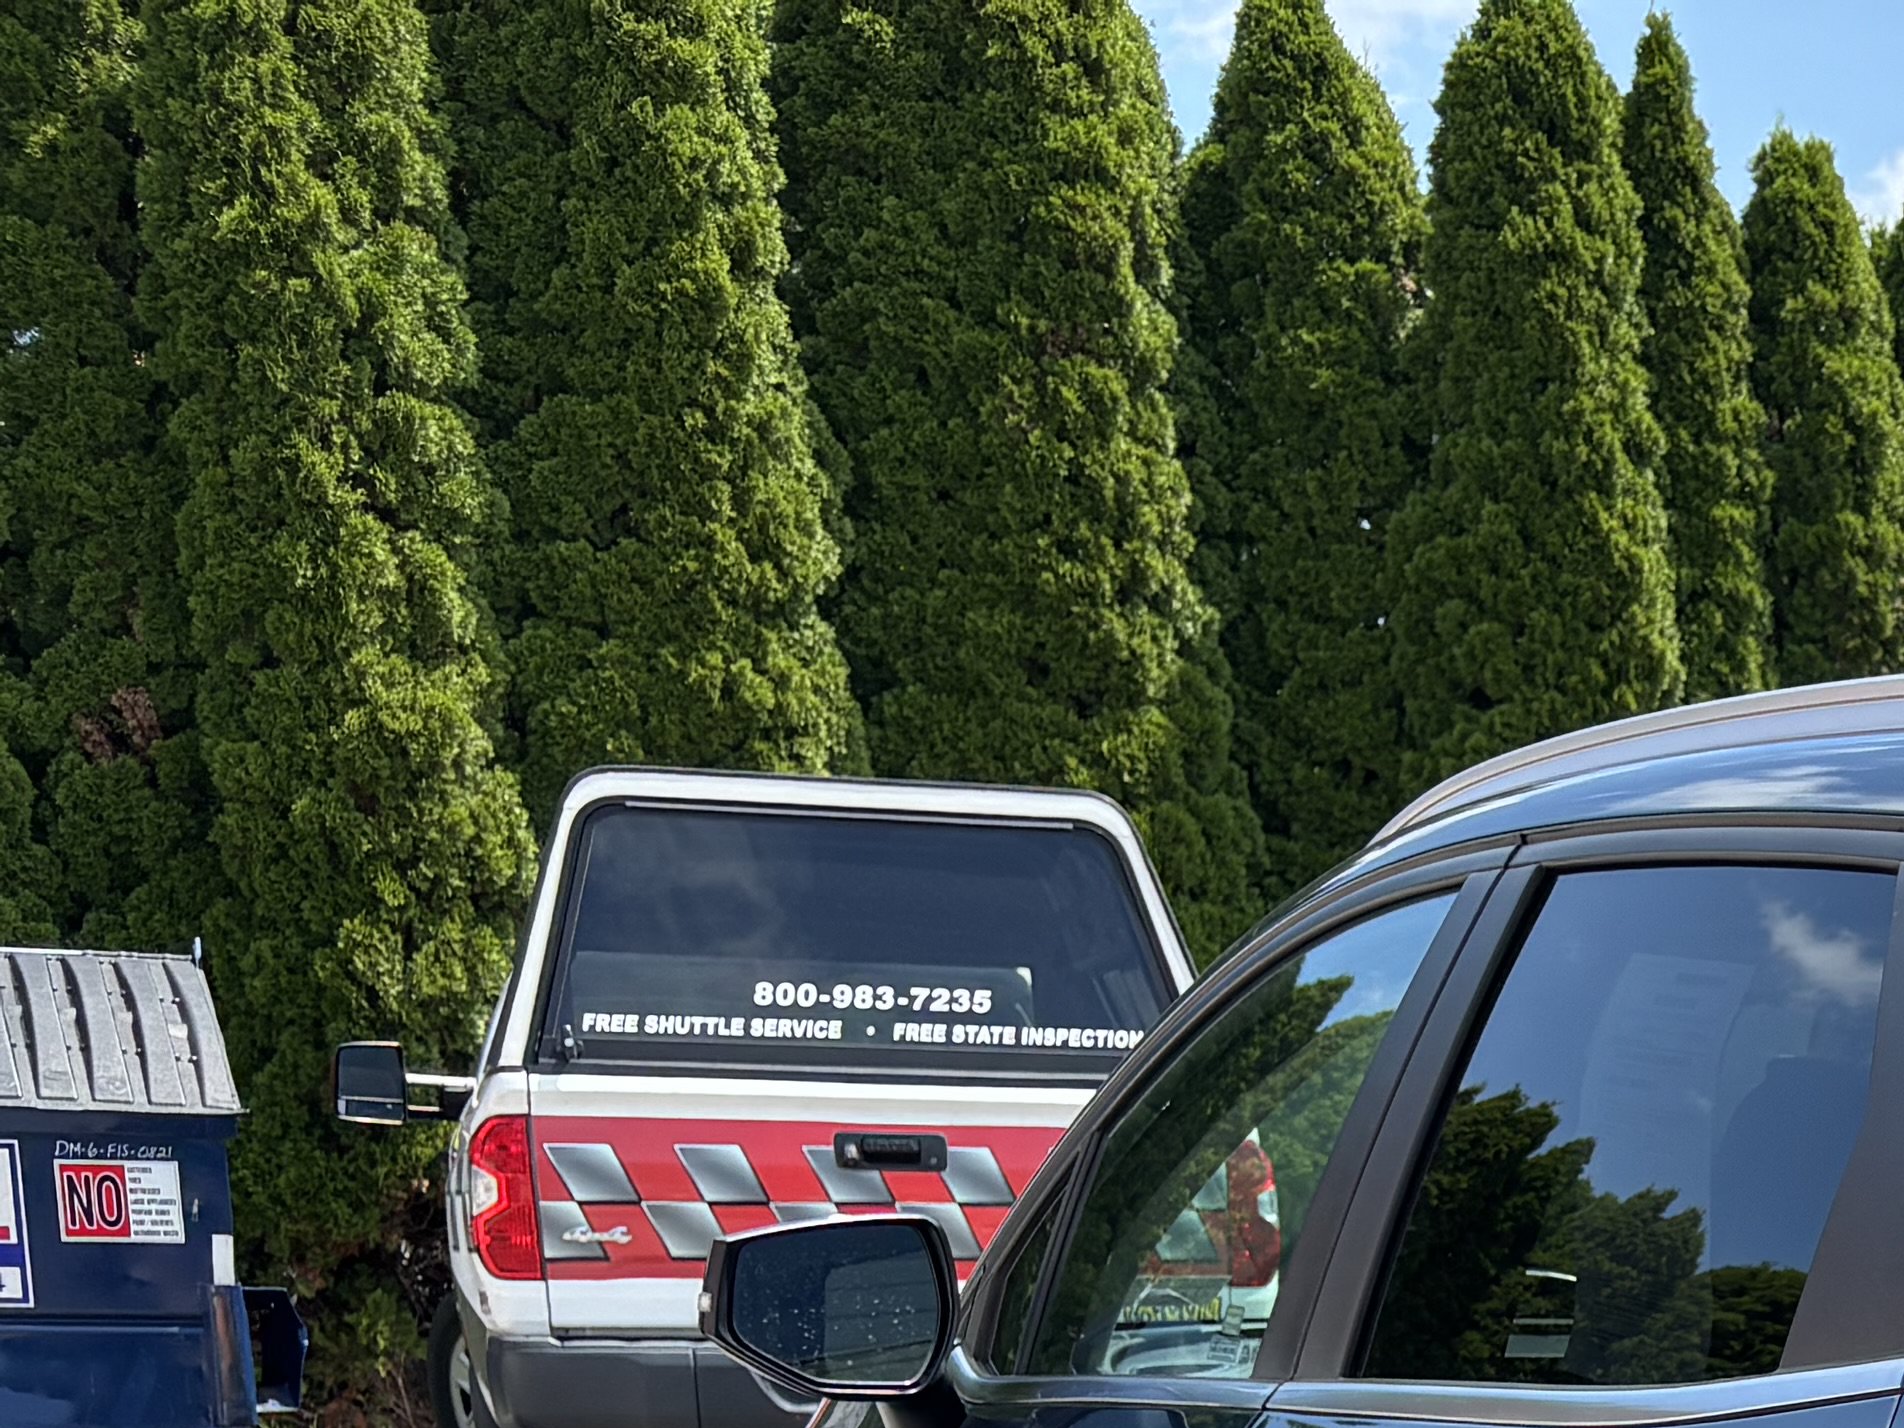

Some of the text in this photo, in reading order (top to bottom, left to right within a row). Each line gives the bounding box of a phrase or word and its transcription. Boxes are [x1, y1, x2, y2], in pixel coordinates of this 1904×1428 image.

[753, 982, 992, 1014] 800-983-7235
[582, 1013, 639, 1033] FREE
[644, 1015, 746, 1037] SHUTTLE
[749, 1018, 843, 1040] SERVICE
[893, 1022, 948, 1044] FREE
[951, 1024, 1017, 1046] STATE
[62, 1171, 126, 1231] NO
